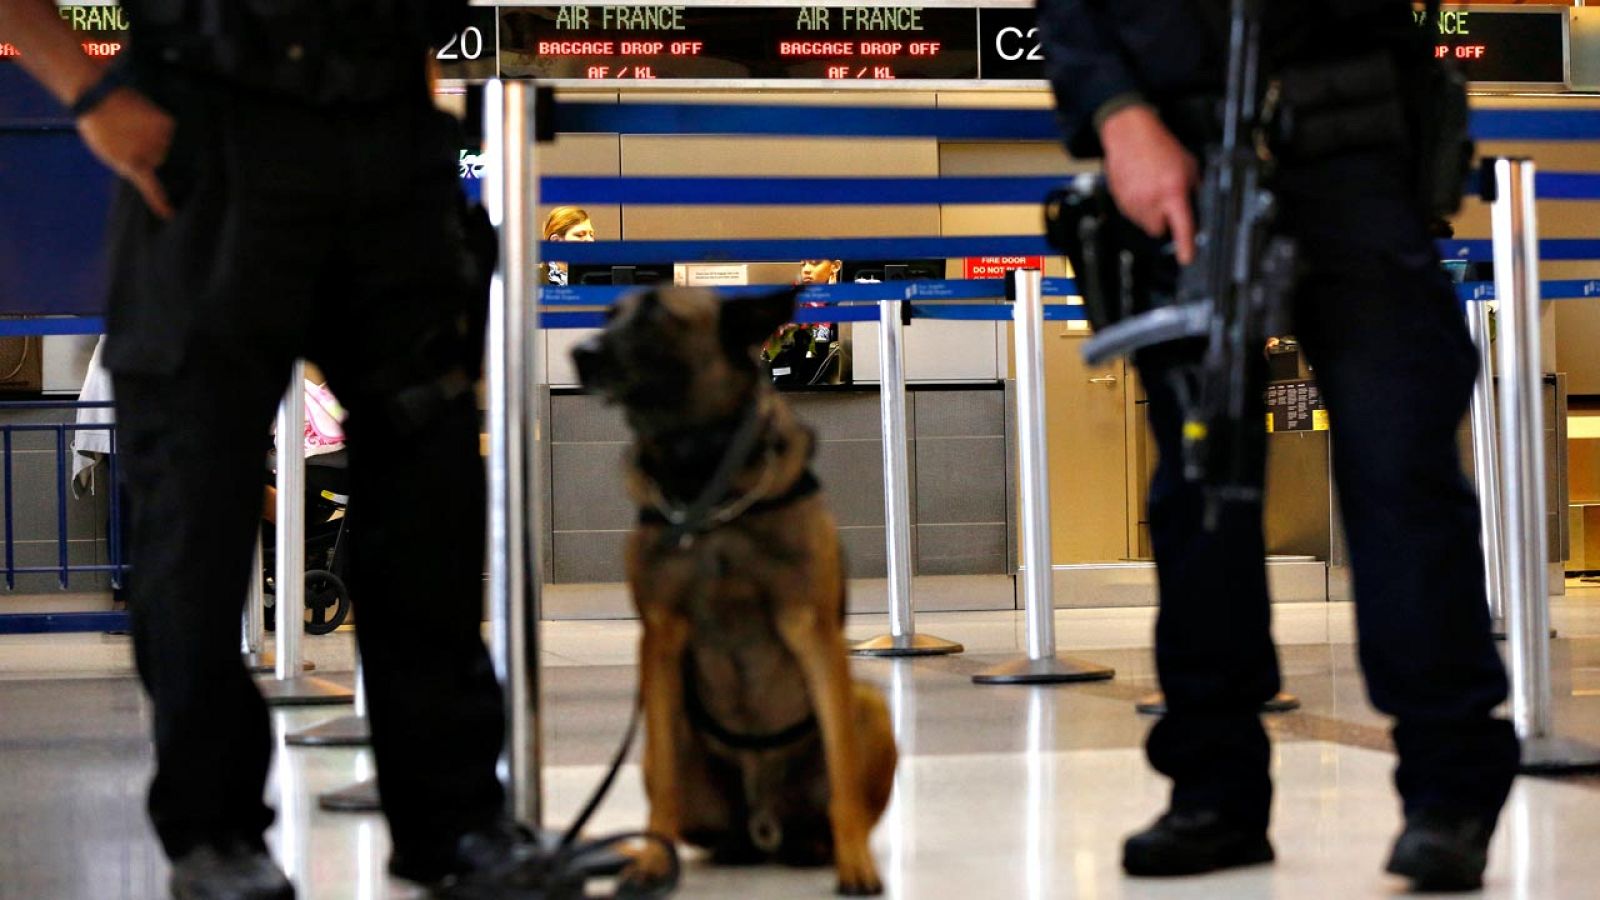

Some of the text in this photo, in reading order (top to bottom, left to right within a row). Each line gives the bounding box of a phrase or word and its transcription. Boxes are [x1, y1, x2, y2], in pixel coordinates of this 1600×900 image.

[60, 5, 129, 31] FRANC
[556, 6, 686, 30] AIR FRANCE
[797, 7, 924, 31] AIR FRANCE
[435, 26, 482, 60] 20
[539, 42, 703, 55] BAGGAGE DROP OFF
[780, 42, 941, 55] BAGGAGE DROP OFF
[995, 26, 1045, 61] C2
[1455, 45, 1485, 58] OFF
[588, 67, 609, 79] AF
[635, 67, 656, 79] KL
[828, 67, 849, 79] AF
[874, 67, 896, 79] KL
[981, 256, 1026, 264] FIRE DOOR
[973, 266, 986, 274] DO
[987, 266, 1005, 274] NOT
